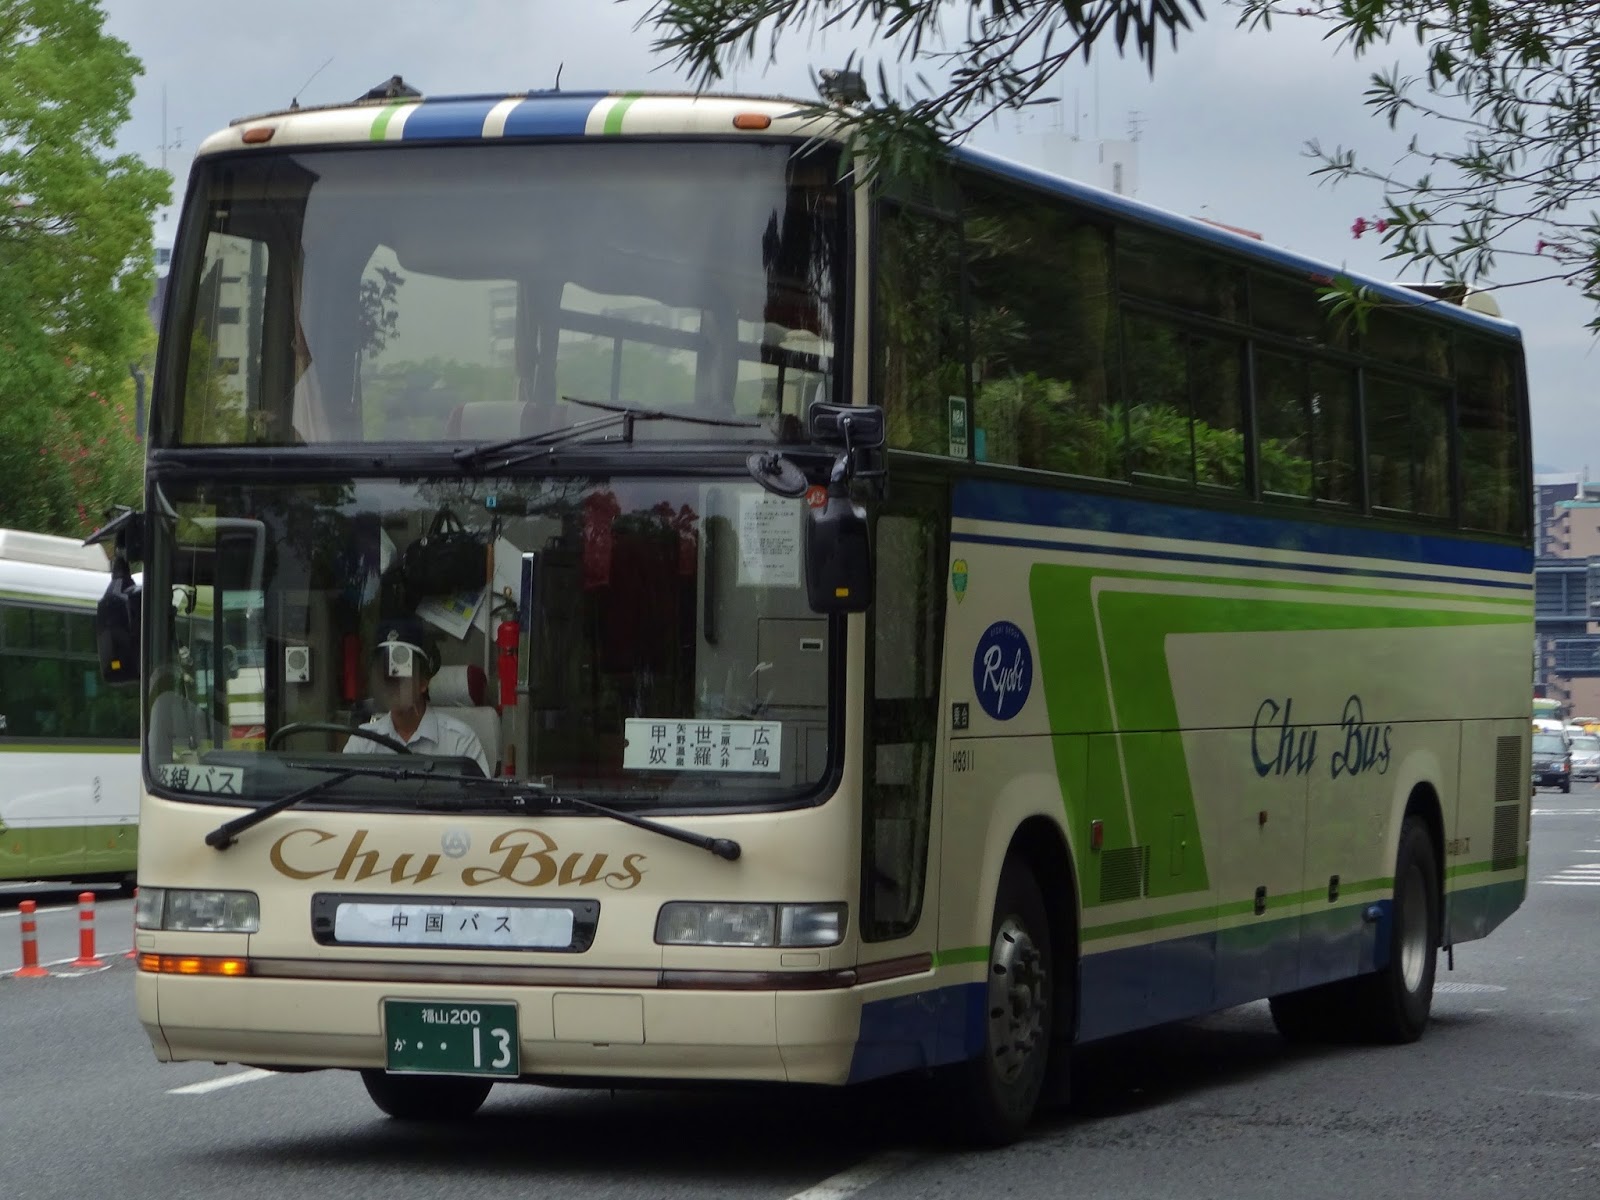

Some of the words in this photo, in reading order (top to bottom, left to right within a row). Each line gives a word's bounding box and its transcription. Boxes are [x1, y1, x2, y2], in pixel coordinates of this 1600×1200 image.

[982, 644, 1024, 714] Ryobi
[649, 725, 667, 765] 甲奴
[693, 725, 713, 767] 世羅
[752, 726, 770, 767] 広島
[1251, 697, 1317, 777] Chu
[1331, 694, 1393, 780] Bus
[270, 828, 442, 884] Chu
[461, 828, 648, 890] Bus
[391, 912, 512, 933] 中国バス
